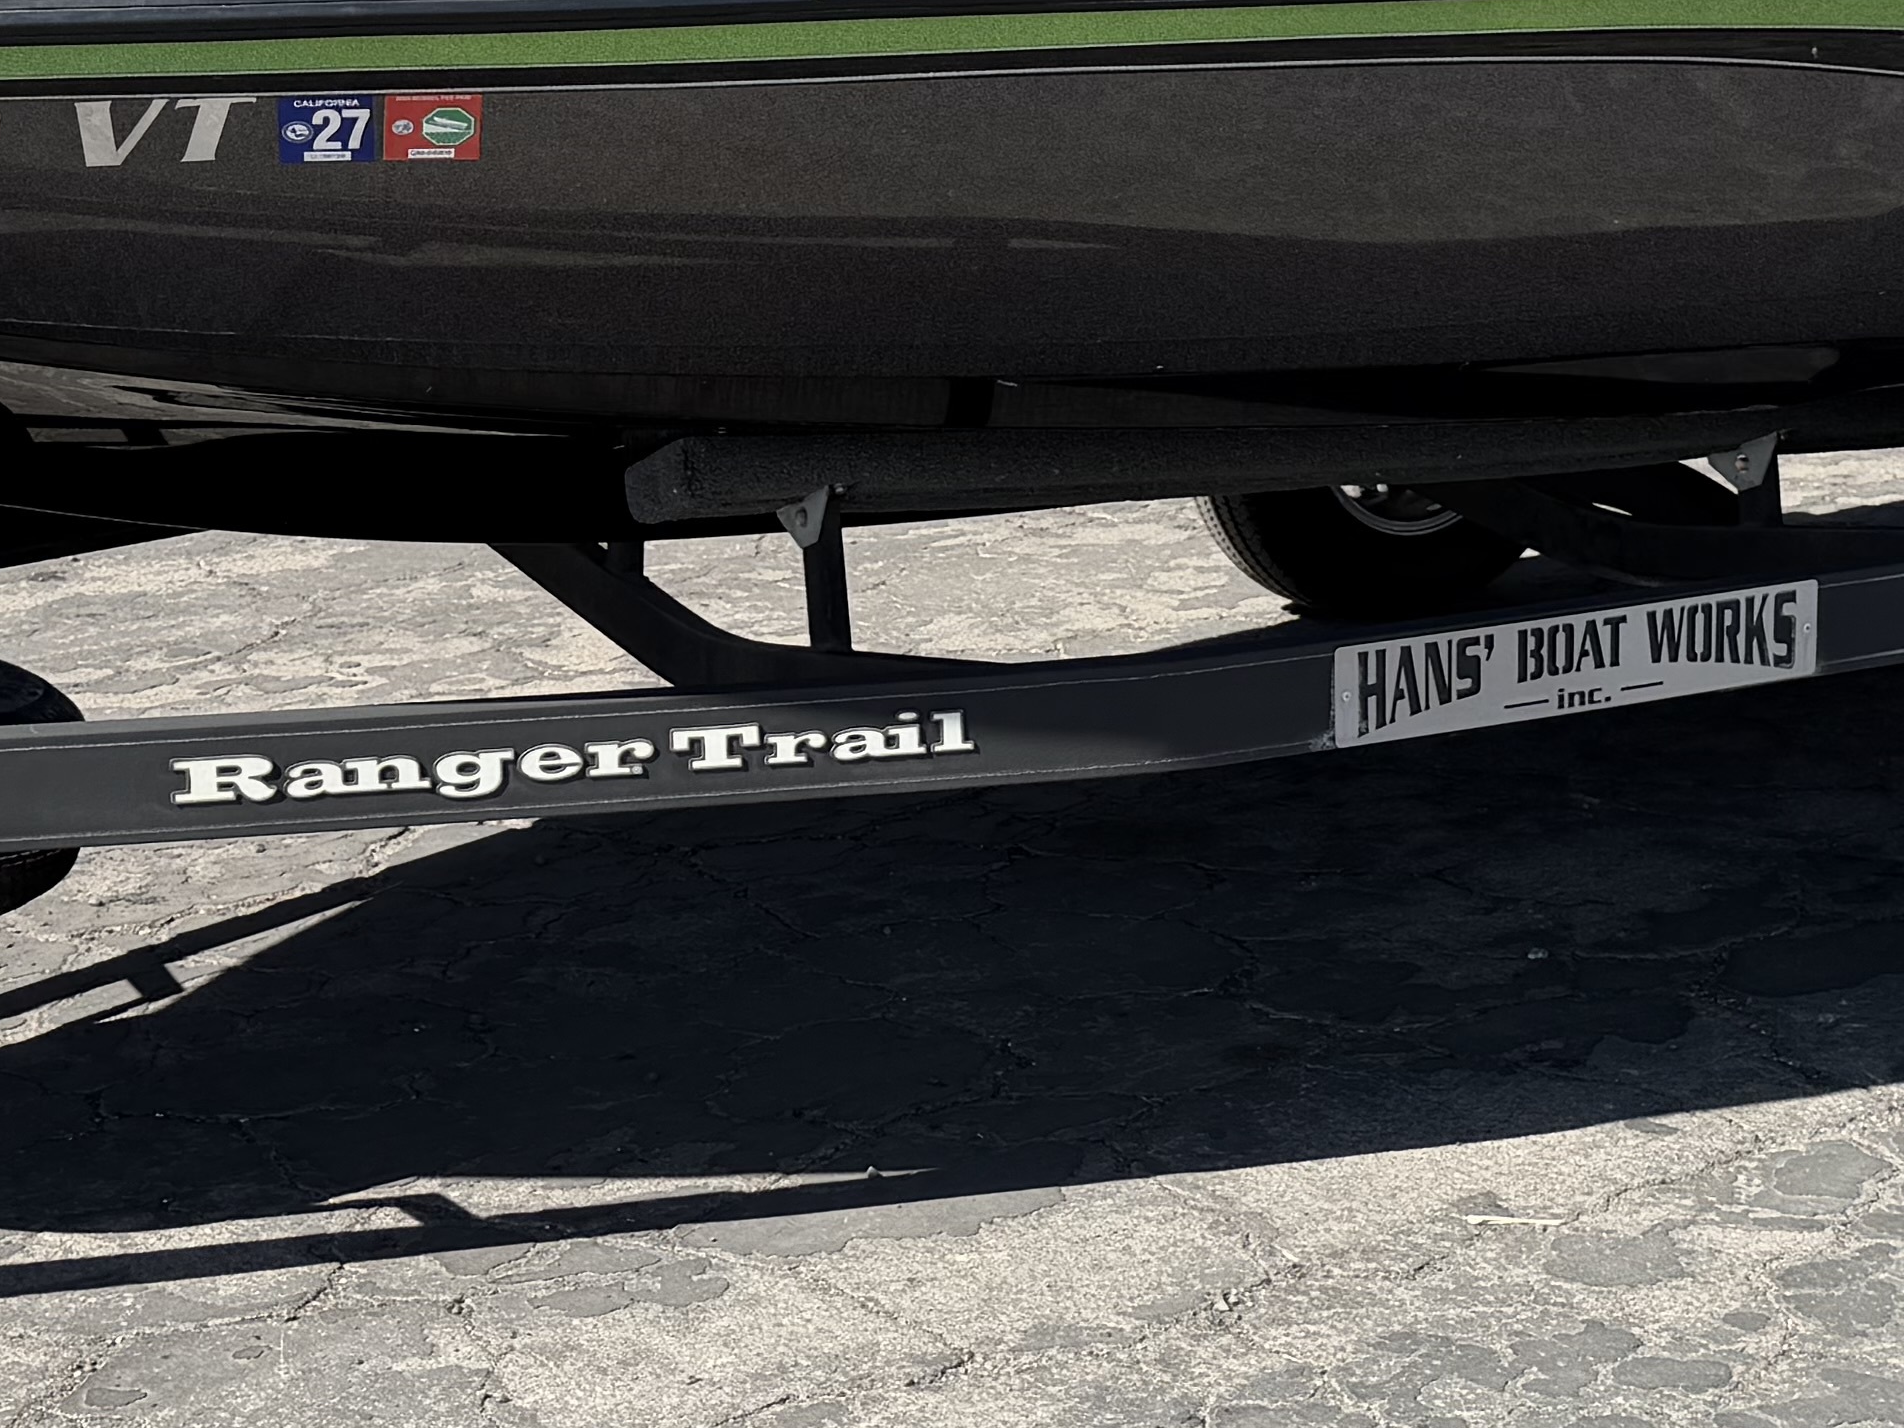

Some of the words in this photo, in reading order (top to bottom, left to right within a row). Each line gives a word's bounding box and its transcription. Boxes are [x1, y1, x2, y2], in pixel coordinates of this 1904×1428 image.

[75, 97, 258, 167] VT
[311, 108, 371, 150] 27
[1357, 633, 1495, 738] HANS'
[1517, 614, 1629, 684] BOAT
[1645, 589, 1797, 670] WORKS
[1556, 684, 1612, 711] inc.
[169, 736, 656, 809] Ranger
[669, 708, 978, 775] Trail
